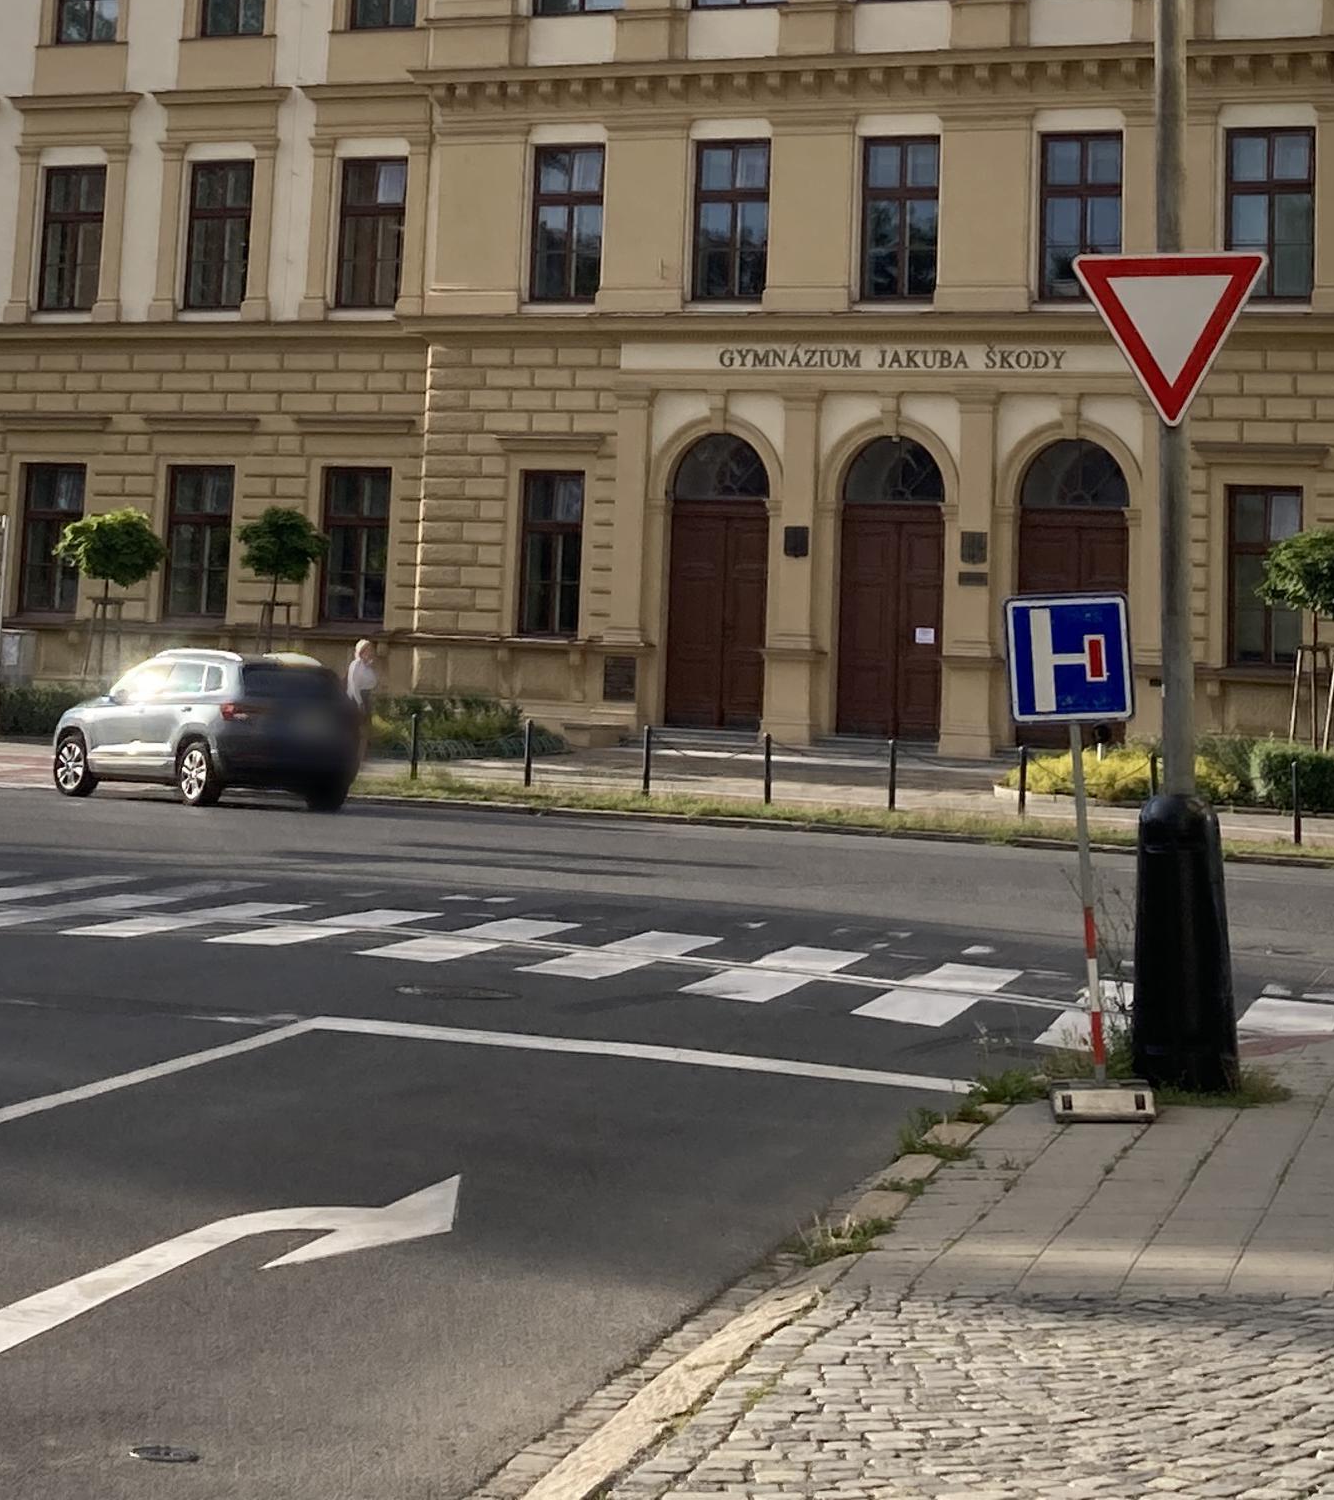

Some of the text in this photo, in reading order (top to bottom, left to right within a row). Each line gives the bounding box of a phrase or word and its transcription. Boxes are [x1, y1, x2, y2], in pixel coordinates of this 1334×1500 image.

[719, 340, 1067, 370] GYMNÁZIUM JAKUBA ŠKODY
